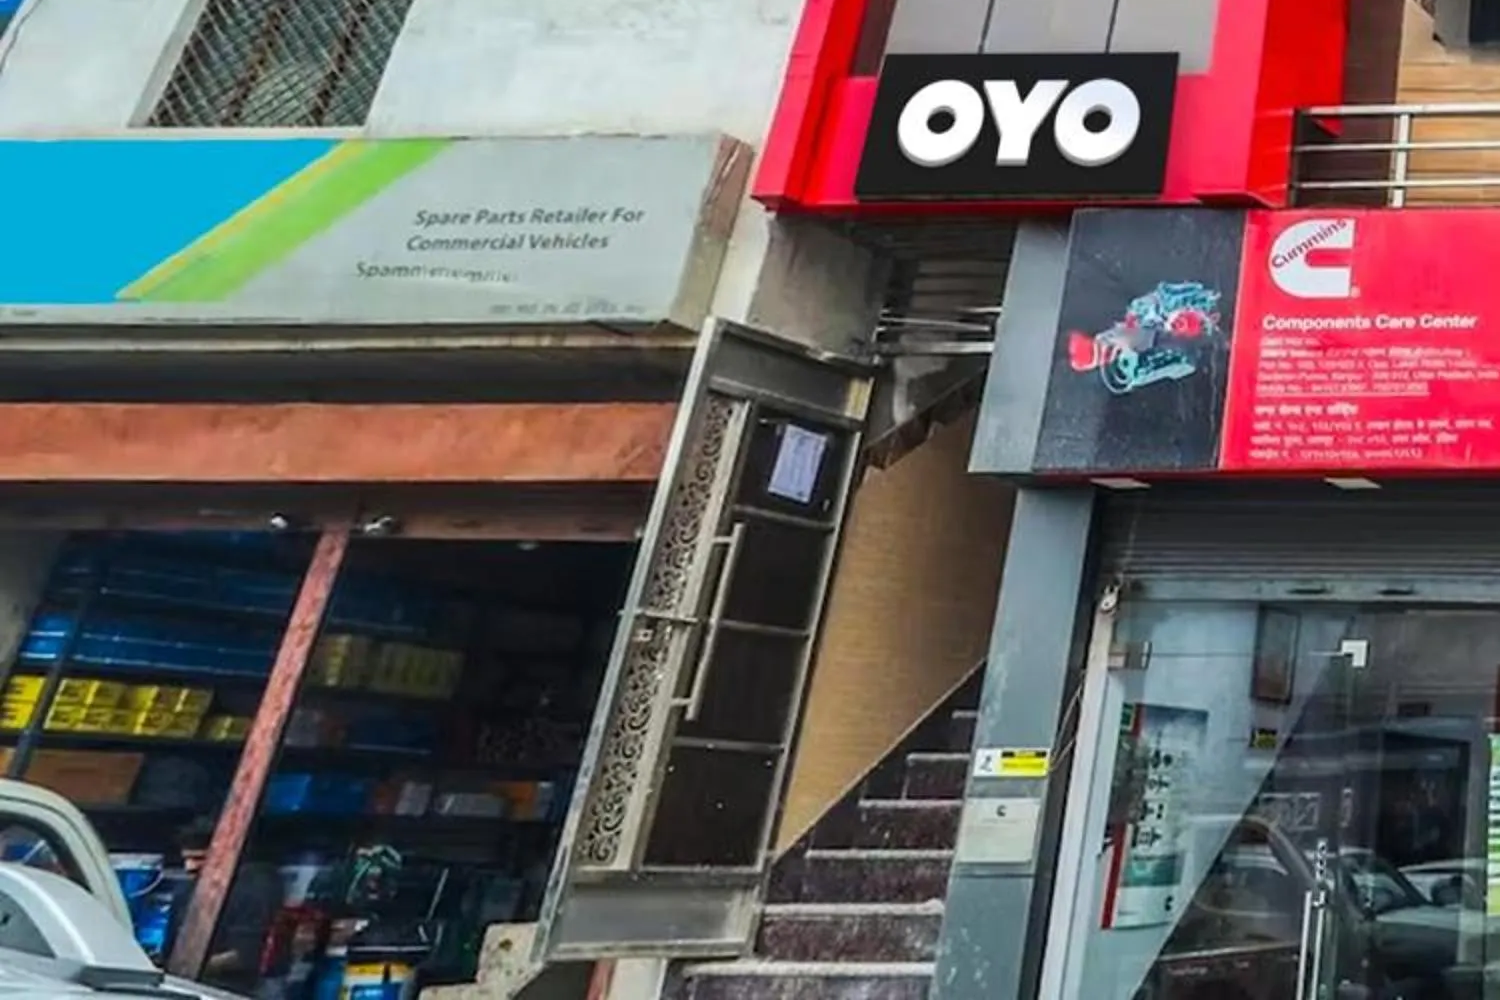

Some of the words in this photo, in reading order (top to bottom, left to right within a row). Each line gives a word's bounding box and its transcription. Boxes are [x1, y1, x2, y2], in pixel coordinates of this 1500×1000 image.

[898, 78, 1140, 167] OYO
[414, 208, 472, 228] Spare
[474, 208, 527, 225] Parts
[529, 207, 609, 224] Retailer
[611, 206, 646, 223] For
[406, 234, 527, 251] Commercial
[527, 232, 611, 250] Vehicles
[1271, 219, 1347, 268] Cummins
[1262, 314, 1370, 332] Components
[1420, 313, 1478, 329] Center
